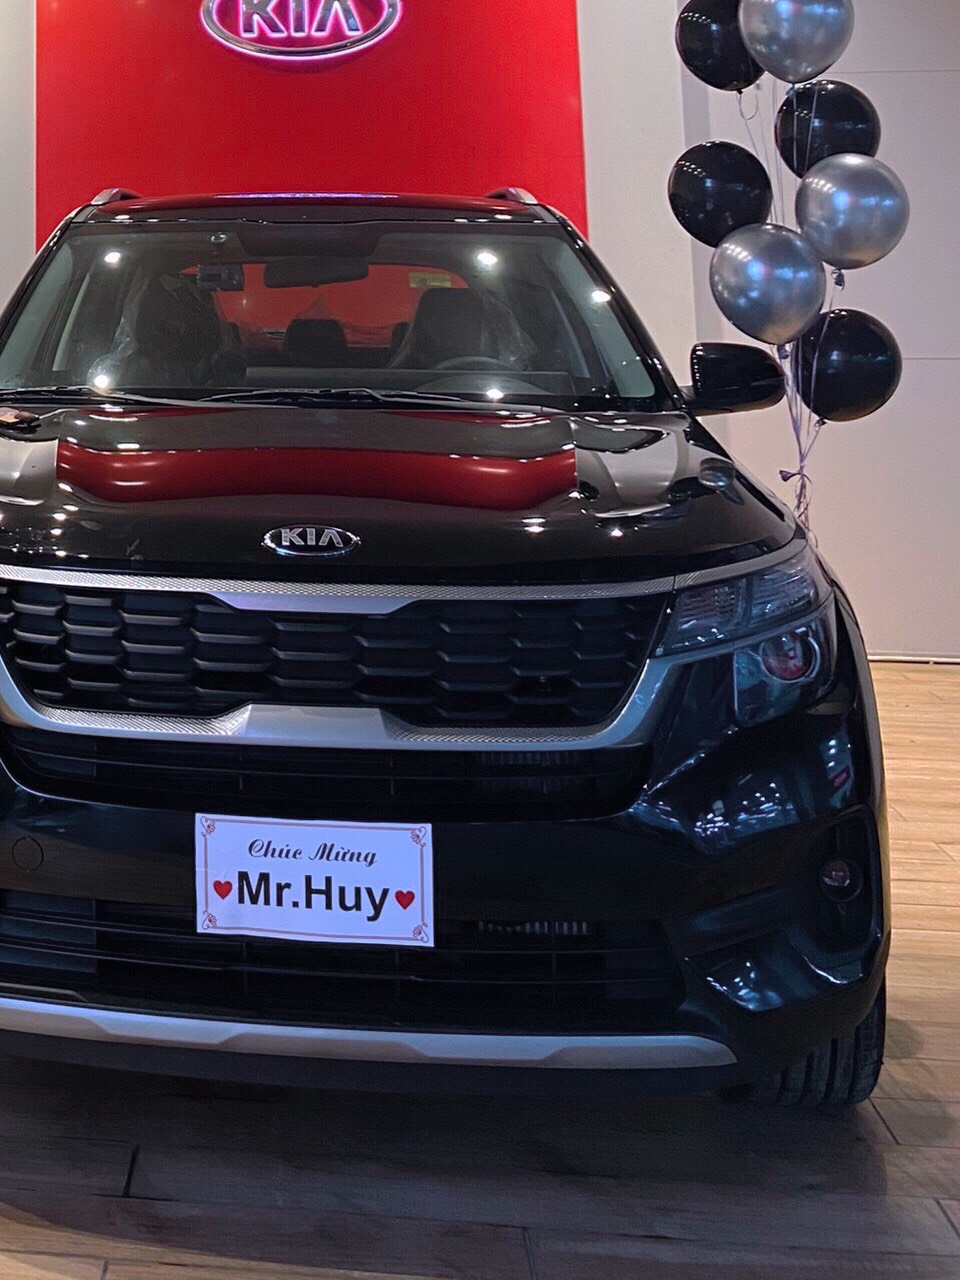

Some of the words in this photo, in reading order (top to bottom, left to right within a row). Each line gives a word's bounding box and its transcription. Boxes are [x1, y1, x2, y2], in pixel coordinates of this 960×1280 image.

[280, 527, 343, 548] KIA
[248, 838, 303, 860] Chúc
[308, 842, 378, 868] Mừng
[237, 870, 390, 922] Mr.Huy
